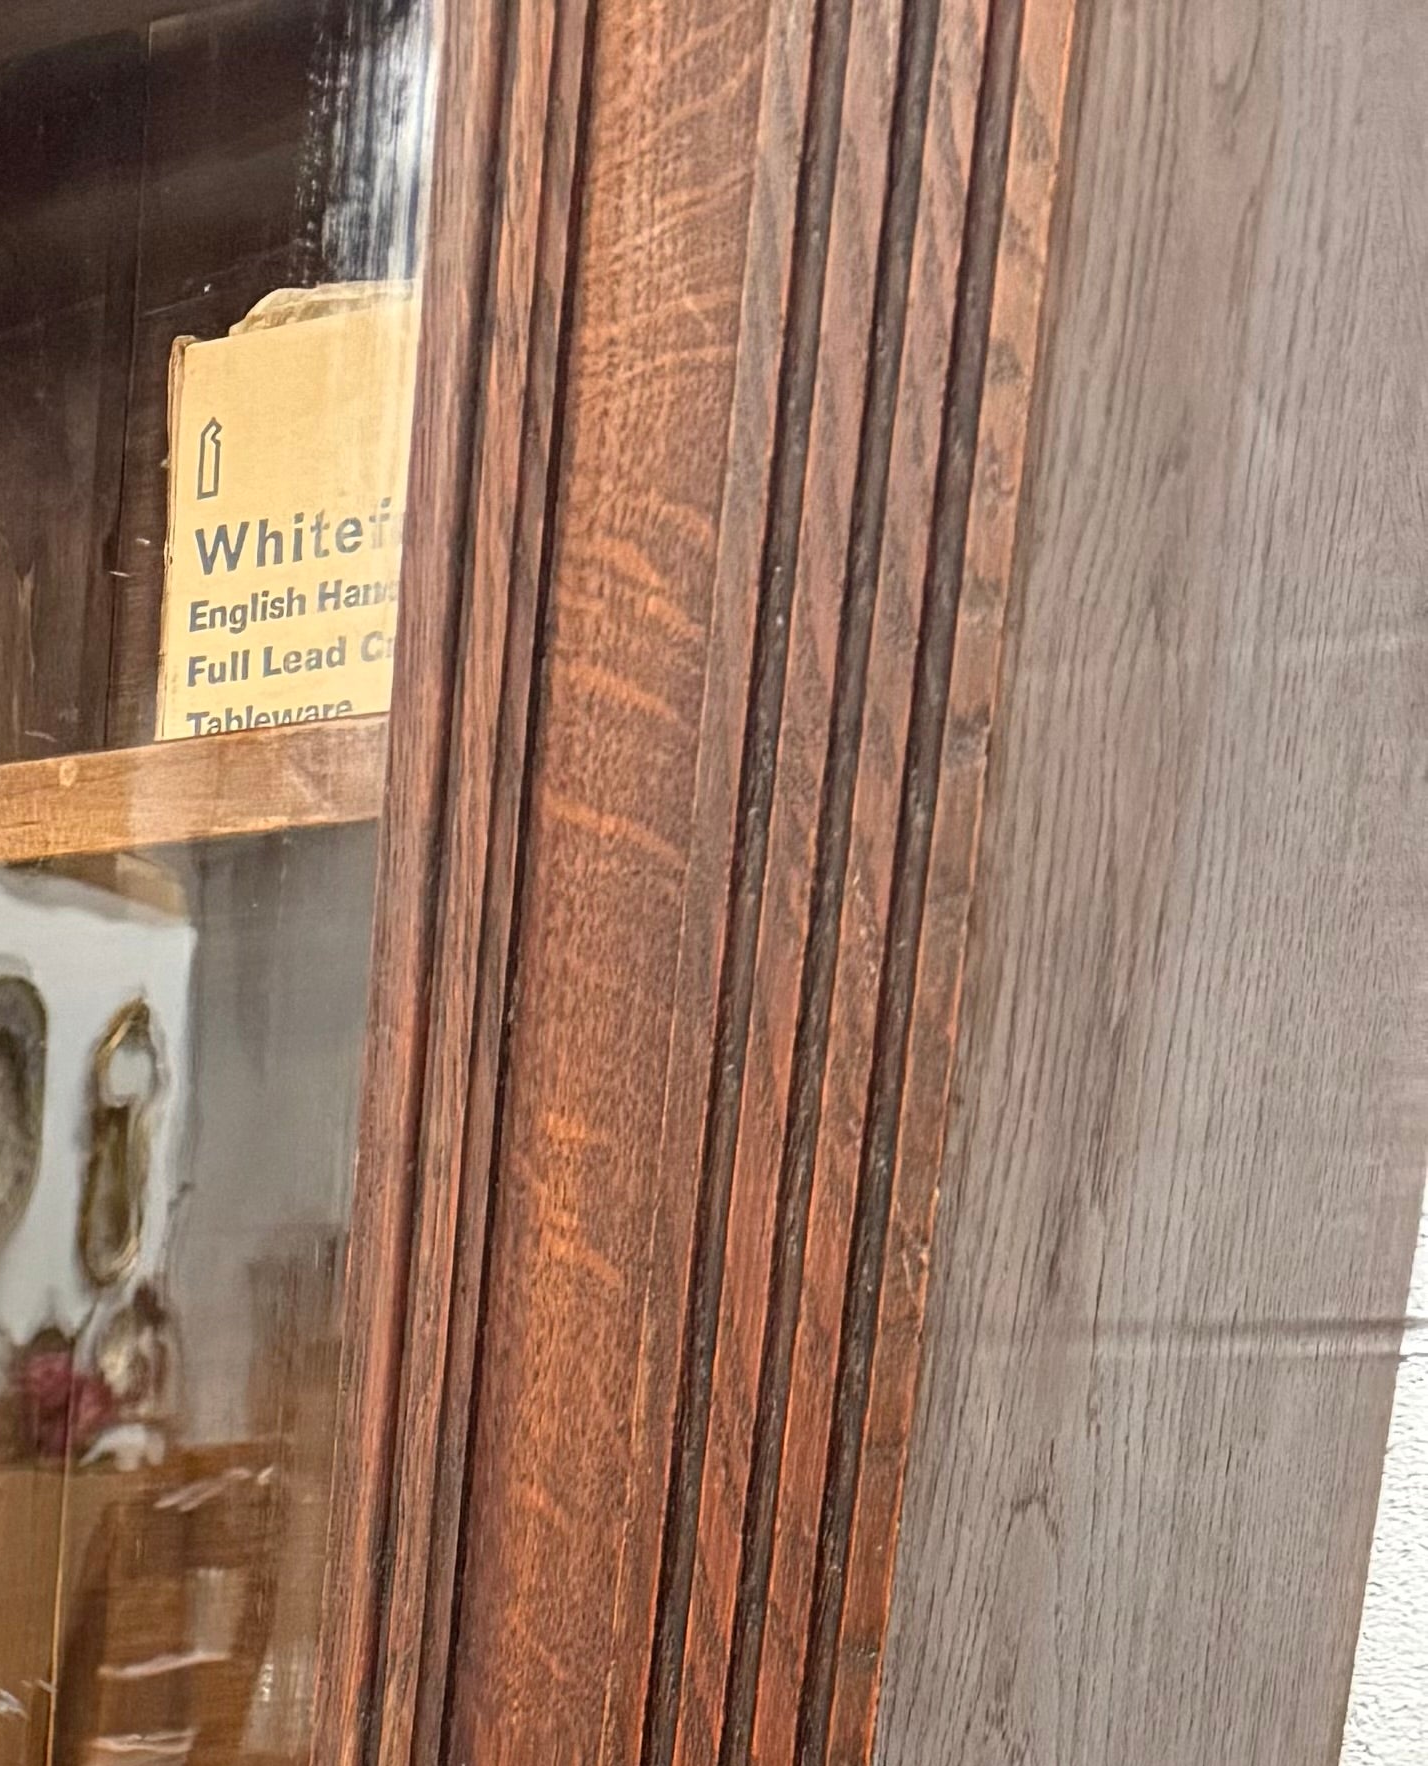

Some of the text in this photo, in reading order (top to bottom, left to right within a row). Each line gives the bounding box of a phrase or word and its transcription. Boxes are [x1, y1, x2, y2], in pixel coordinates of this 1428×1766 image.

[194, 497, 399, 576] Whitef
[189, 586, 306, 634] English
[187, 648, 250, 687] Full
[263, 635, 346, 678] Lead
[186, 699, 353, 737] Tableware
